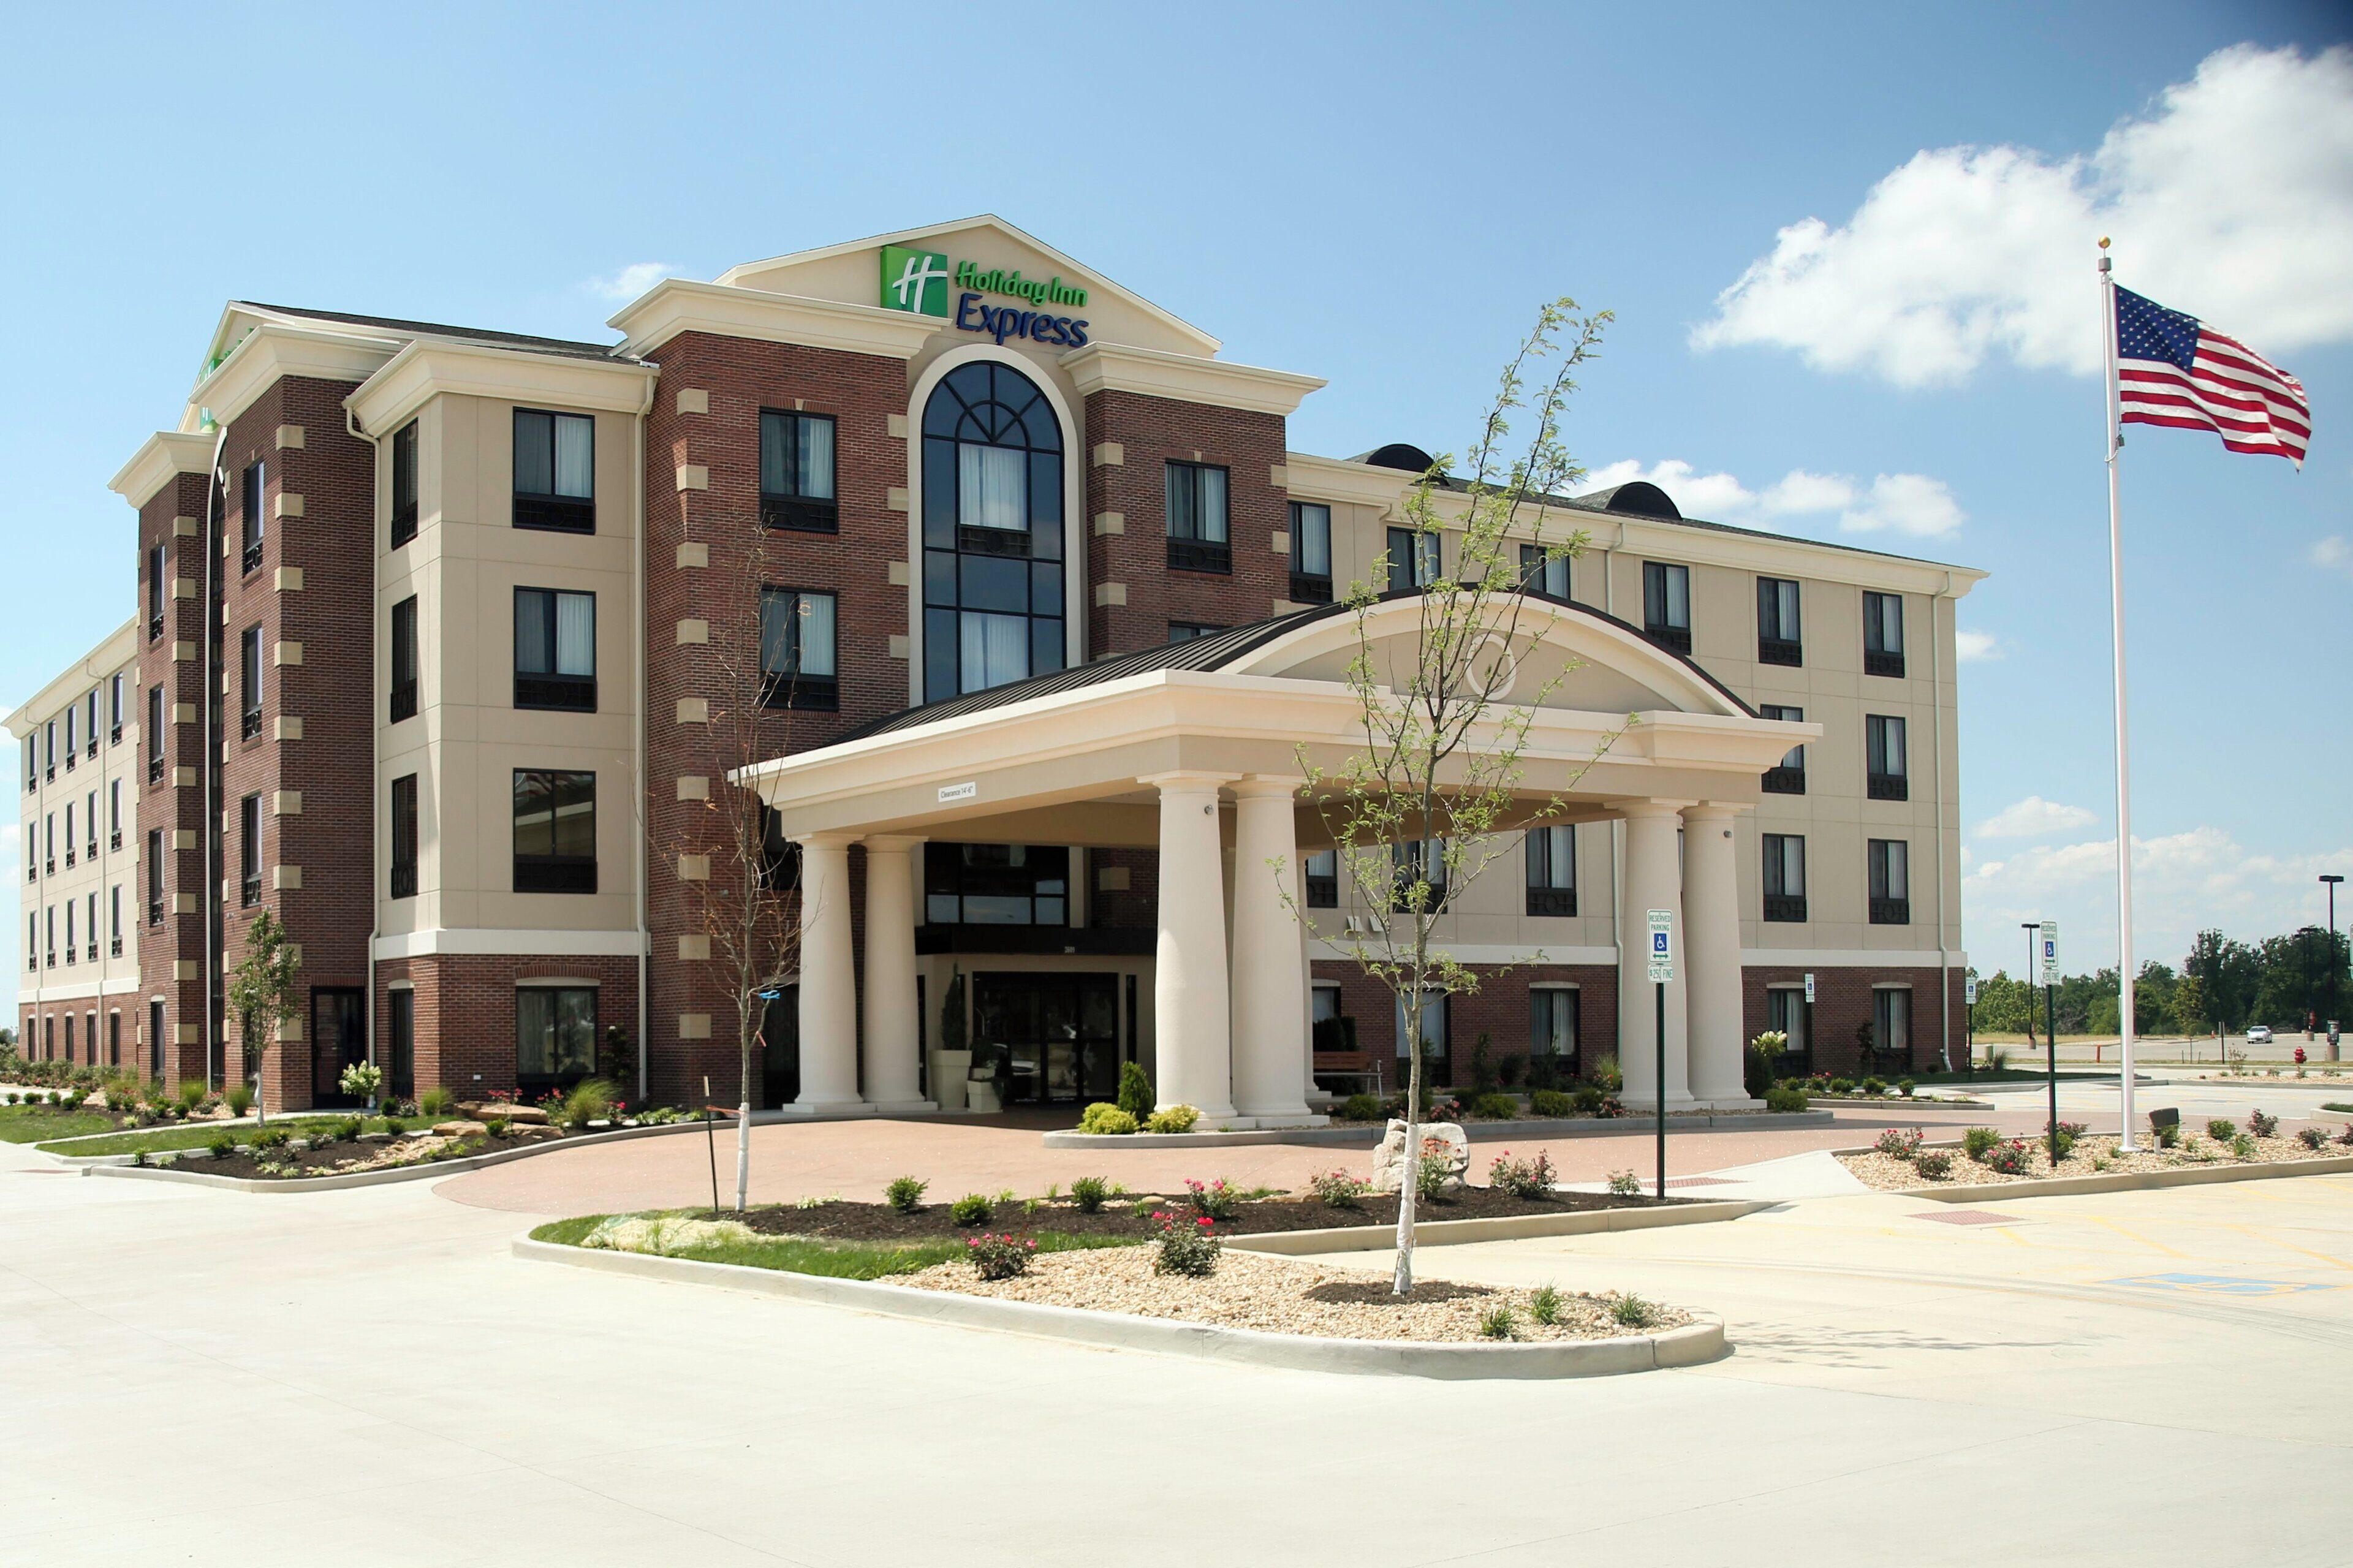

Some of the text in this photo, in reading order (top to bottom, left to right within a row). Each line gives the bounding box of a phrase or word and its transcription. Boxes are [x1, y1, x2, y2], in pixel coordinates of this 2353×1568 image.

[955, 260, 1088, 307] Holiday Inn
[957, 293, 1089, 347] Express
[941, 790, 960, 798] Clearance
[1663, 969, 1673, 979] FINE
